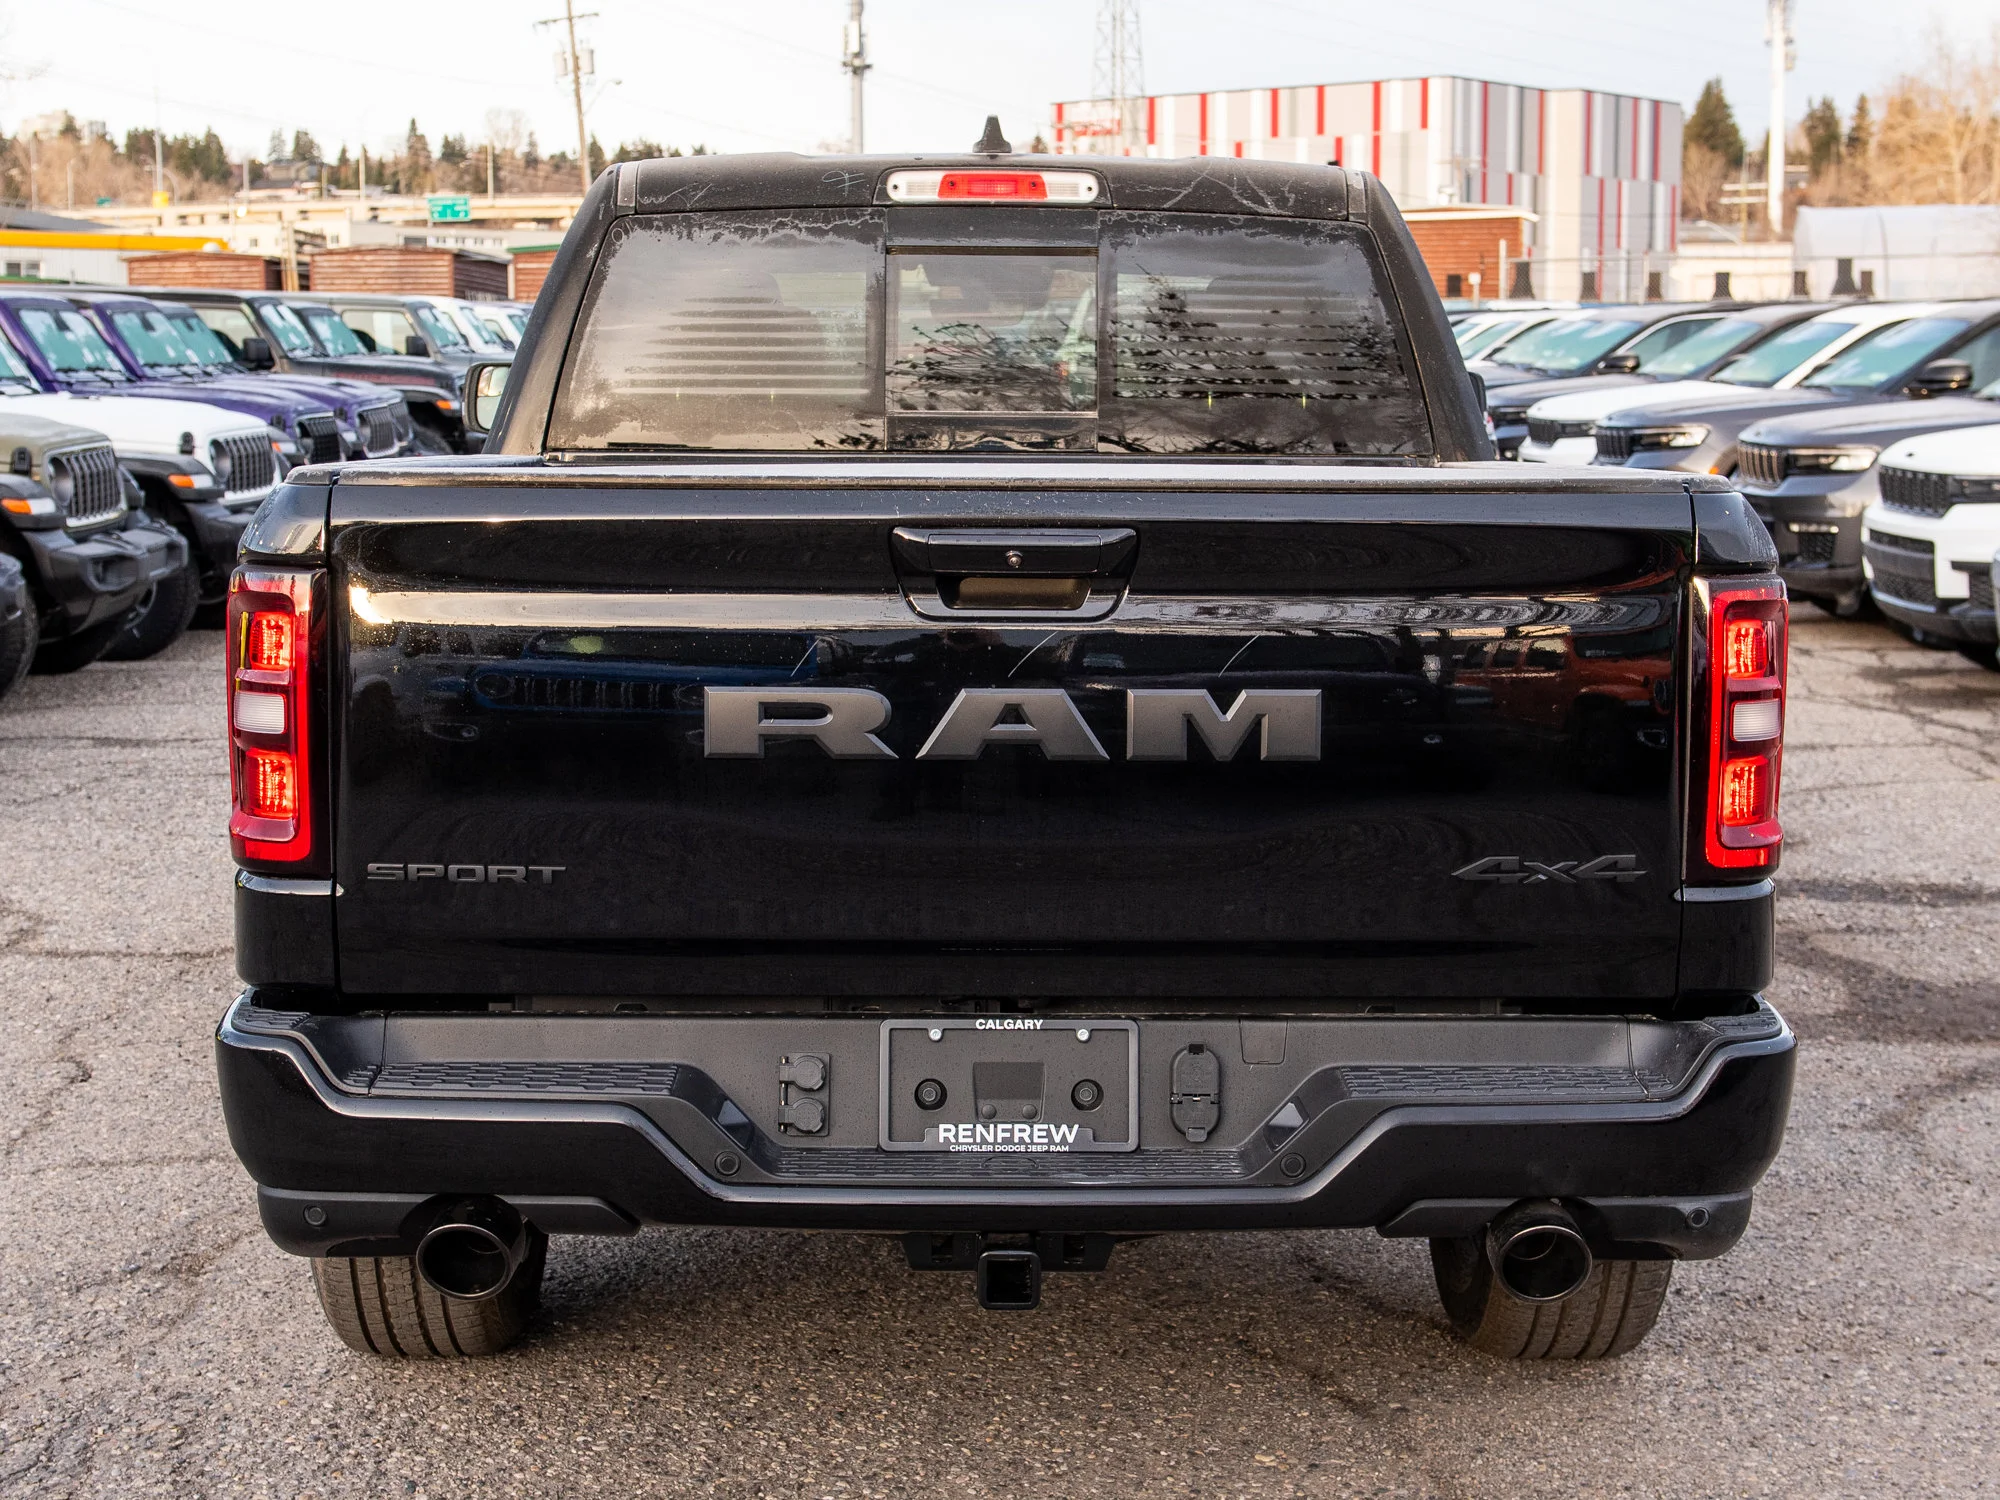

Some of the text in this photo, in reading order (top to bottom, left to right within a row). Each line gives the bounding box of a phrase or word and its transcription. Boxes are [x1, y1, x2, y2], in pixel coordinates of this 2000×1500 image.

[704, 686, 1322, 761] RAM
[367, 863, 567, 884] SPORT
[975, 1019, 1043, 1030] CALGARY
[938, 1123, 1079, 1143] RENFREW
[949, 1144, 1069, 1152] CHRYSLER DODGE JEEP RAM
